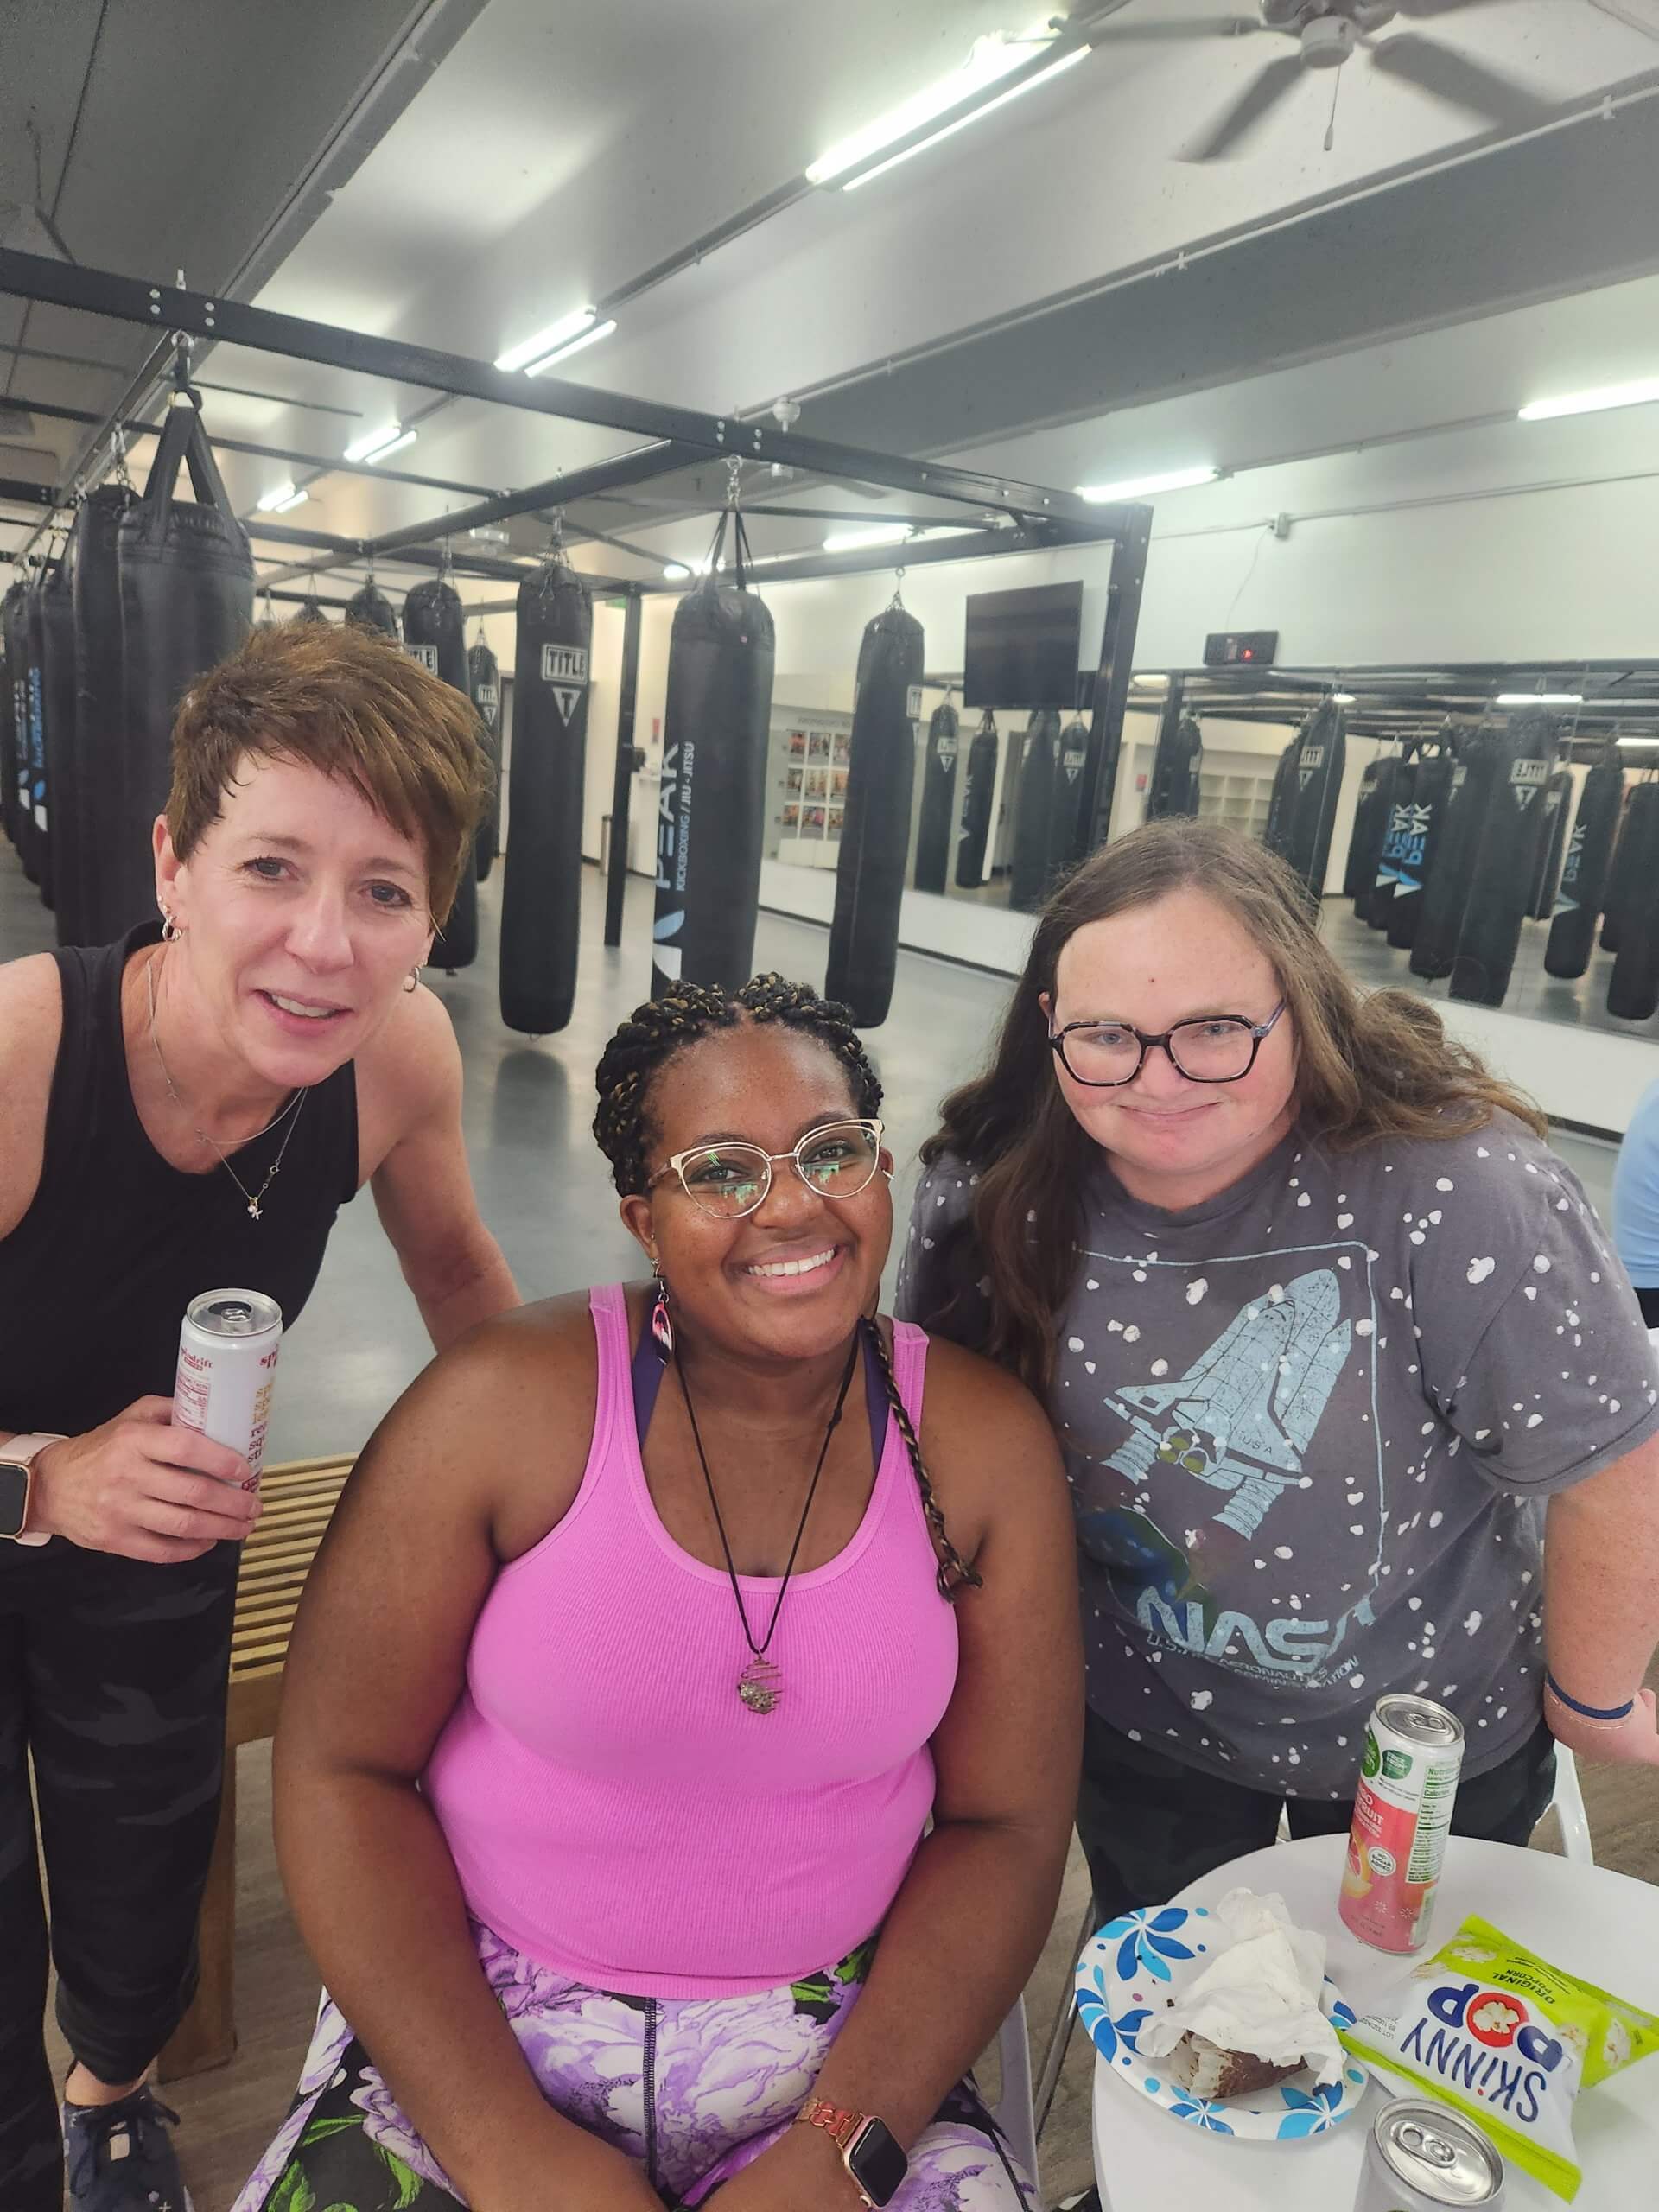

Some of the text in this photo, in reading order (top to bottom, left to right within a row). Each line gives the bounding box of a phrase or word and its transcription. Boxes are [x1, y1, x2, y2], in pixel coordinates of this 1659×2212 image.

[546, 647, 587, 681] TITLE
[676, 815, 690, 892] KICKBOXING
[1492, 1972, 1556, 2005] ORIGINAL
[1505, 1968, 1552, 1994] POPCORN
[1427, 1983, 1563, 2073] POP
